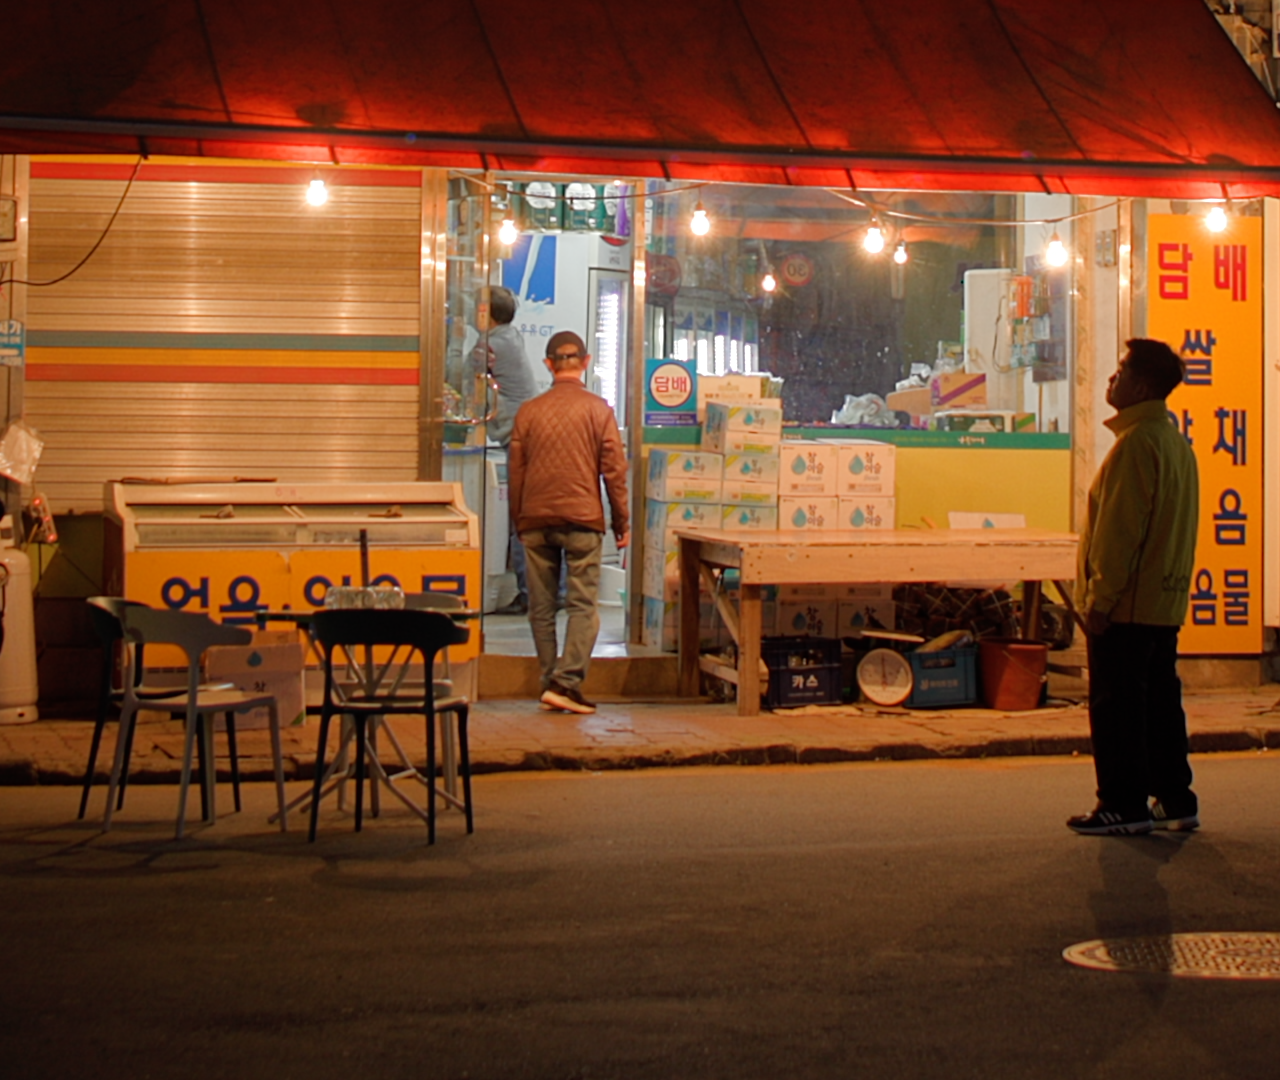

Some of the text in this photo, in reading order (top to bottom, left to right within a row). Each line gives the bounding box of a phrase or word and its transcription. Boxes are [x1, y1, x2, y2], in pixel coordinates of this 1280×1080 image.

[1158, 242, 1249, 302] 담배
[654, 375, 688, 394] 담배
[1213, 487, 1249, 547] 음
[1190, 568, 1251, 627] 음물
[791, 674, 819, 689] 카스
